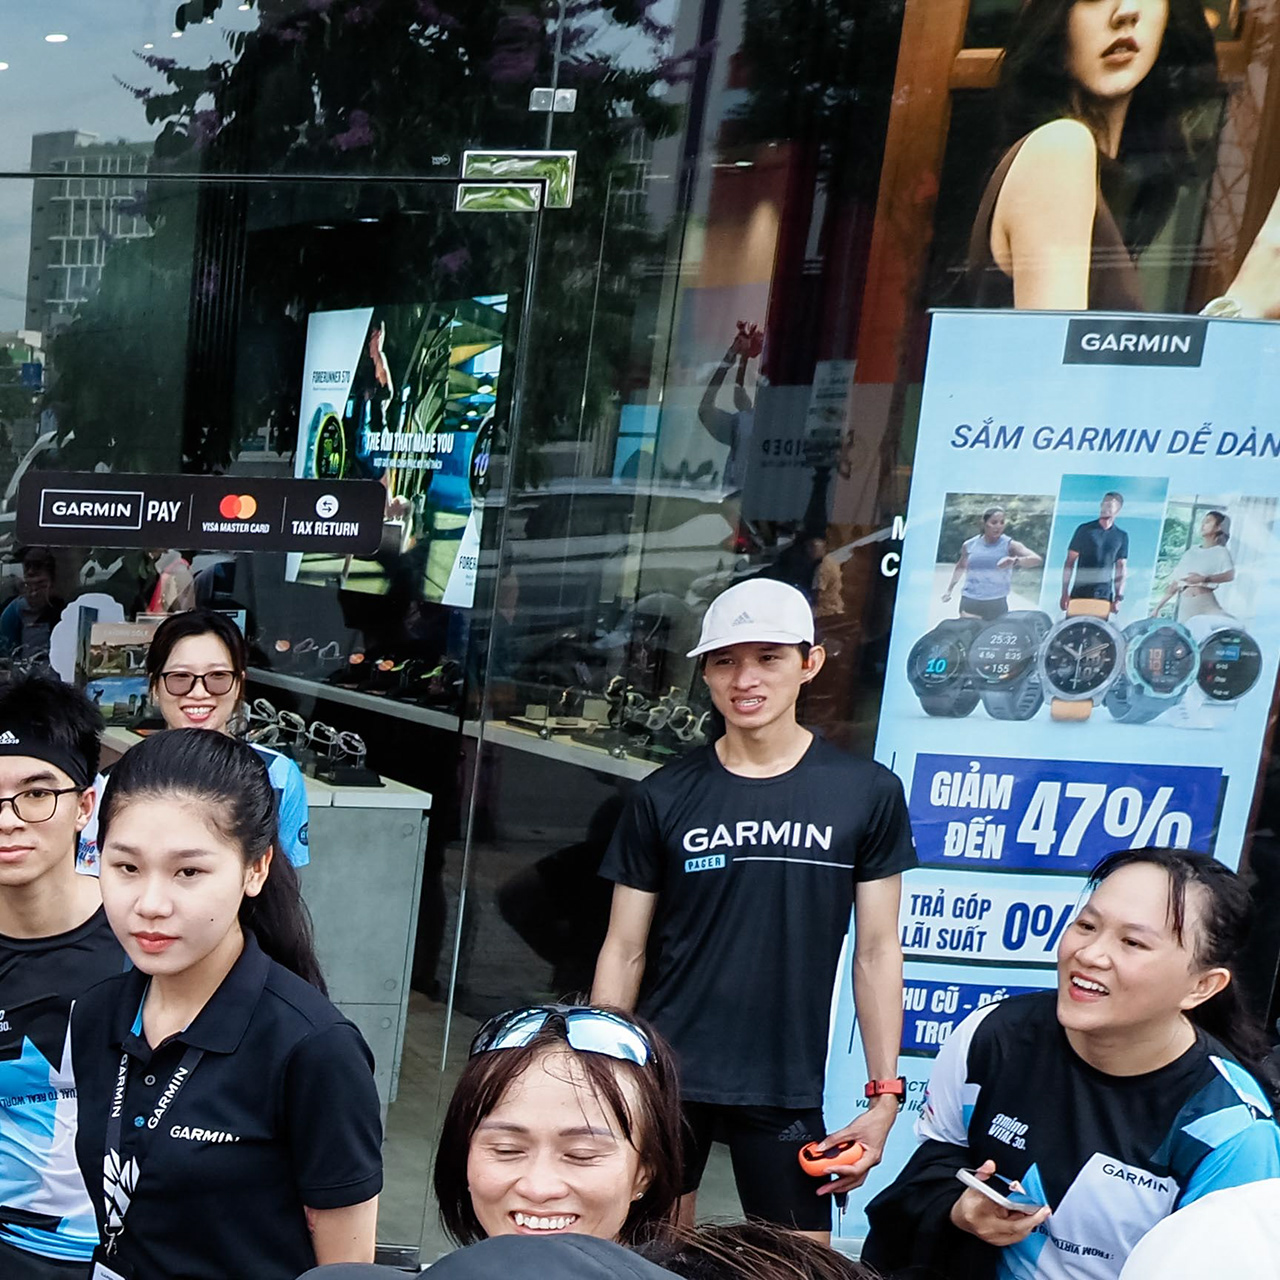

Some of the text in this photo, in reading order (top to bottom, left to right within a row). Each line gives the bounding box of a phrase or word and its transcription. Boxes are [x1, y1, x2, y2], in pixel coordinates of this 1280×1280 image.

[1080, 333, 1191, 354] GARMIN
[438, 433, 453, 453] YOU
[951, 417, 1024, 450] SẮM
[1032, 426, 1160, 455] GARMIN
[1167, 421, 1212, 455] DỄ
[52, 501, 180, 522] GARMIN PAY
[202, 522, 269, 533] VISA MASTER CARD
[292, 521, 358, 536] TAX RETURN
[930, 761, 1014, 810] GIẢM
[944, 781, 1193, 860] ĐẾN 47%
[683, 820, 832, 853] GARMIN
[687, 856, 722, 870] PACER
[910, 888, 992, 920] TRẢ GÓP
[902, 919, 929, 948] LÃI
[936, 922, 987, 953] SUẤT
[931, 985, 960, 1013] CŨ
[112, 1054, 128, 1118] GARMIN
[147, 1066, 189, 1129] GARMIN
[1102, 1163, 1169, 1194] GARMIN
